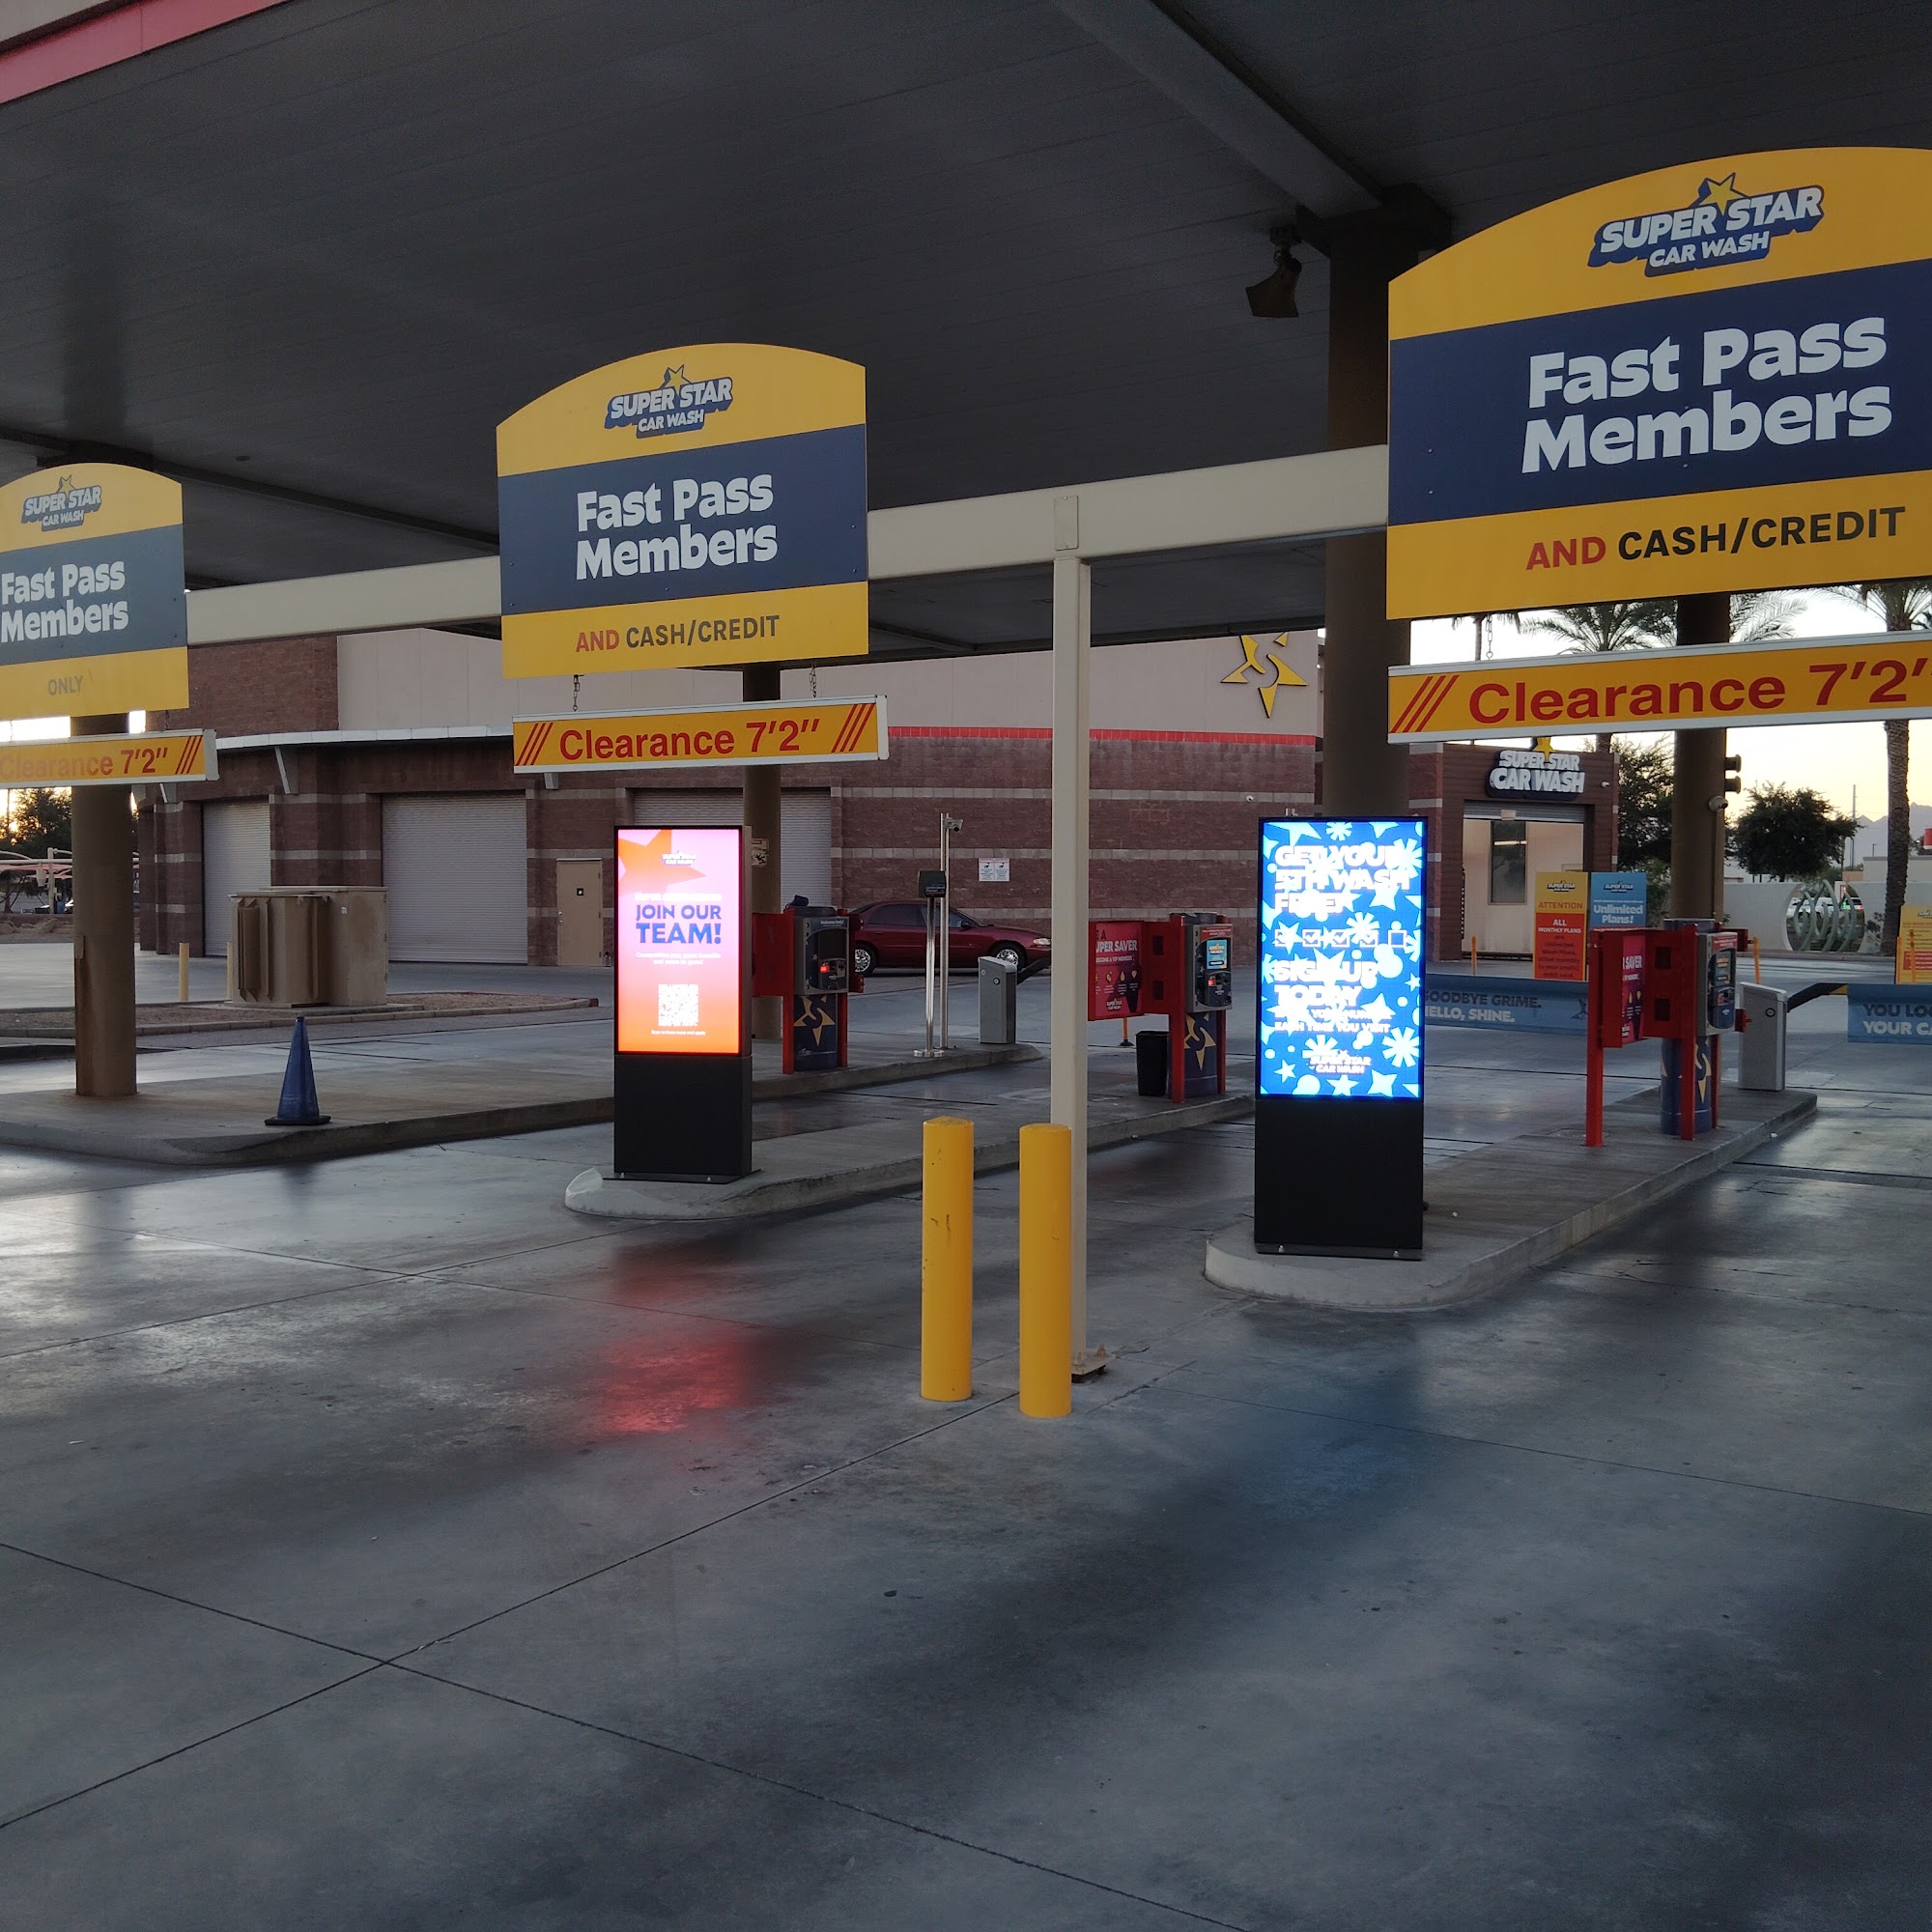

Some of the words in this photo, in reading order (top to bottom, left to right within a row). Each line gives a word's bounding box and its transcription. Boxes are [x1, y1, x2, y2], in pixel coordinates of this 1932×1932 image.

[1601, 206, 1717, 252] SUPER
[1725, 187, 1824, 231] STAR
[1649, 243, 1696, 268] CAR
[1701, 231, 1771, 259] WASH
[1528, 336, 1680, 409] Fast
[1703, 317, 1888, 386] Pass
[611, 387, 675, 419] SUPER
[680, 378, 732, 408] STAR
[638, 415, 665, 432] CAR
[667, 410, 704, 427] WASH
[1521, 385, 1892, 473] Members
[24, 491, 66, 516] SUPER
[69, 486, 101, 509] STAR
[577, 483, 662, 532] Fast
[673, 473, 774, 521] Pass
[43, 514, 59, 526] CAR
[60, 510, 84, 524] WASH
[1525, 535, 1606, 571] AND
[1618, 505, 1906, 561] CASH/CREDIT
[576, 524, 778, 580] Members
[1, 566, 55, 605] Fast
[62, 560, 126, 597] Pass
[1, 599, 129, 643] Members
[576, 629, 620, 652] AND
[626, 614, 781, 649] CASH/CREDIT
[48, 675, 83, 696] ONLY
[1469, 673, 1786, 724] Clearance
[559, 727, 735, 761] Clearance
[0, 754, 114, 780] Clearance
[1499, 750, 1546, 769] SUPER
[1548, 753, 1580, 771] STAR
[1490, 768, 1531, 790] CAR
[1534, 770, 1585, 793] WASH
[636, 905, 675, 922] JOIN
[681, 904, 722, 920] OUR
[1594, 903, 1643, 914] Unlimited
[1602, 914, 1634, 923] Plans!
[636, 923, 722, 944] TEAM!
[1114, 940, 1137, 952] SAVER
[1625, 955, 1642, 969] SAVER
[1468, 1008, 1516, 1022] SHINE.
[1862, 1004, 1901, 1017] YOU
[1862, 1021, 1913, 1036] YOUR
